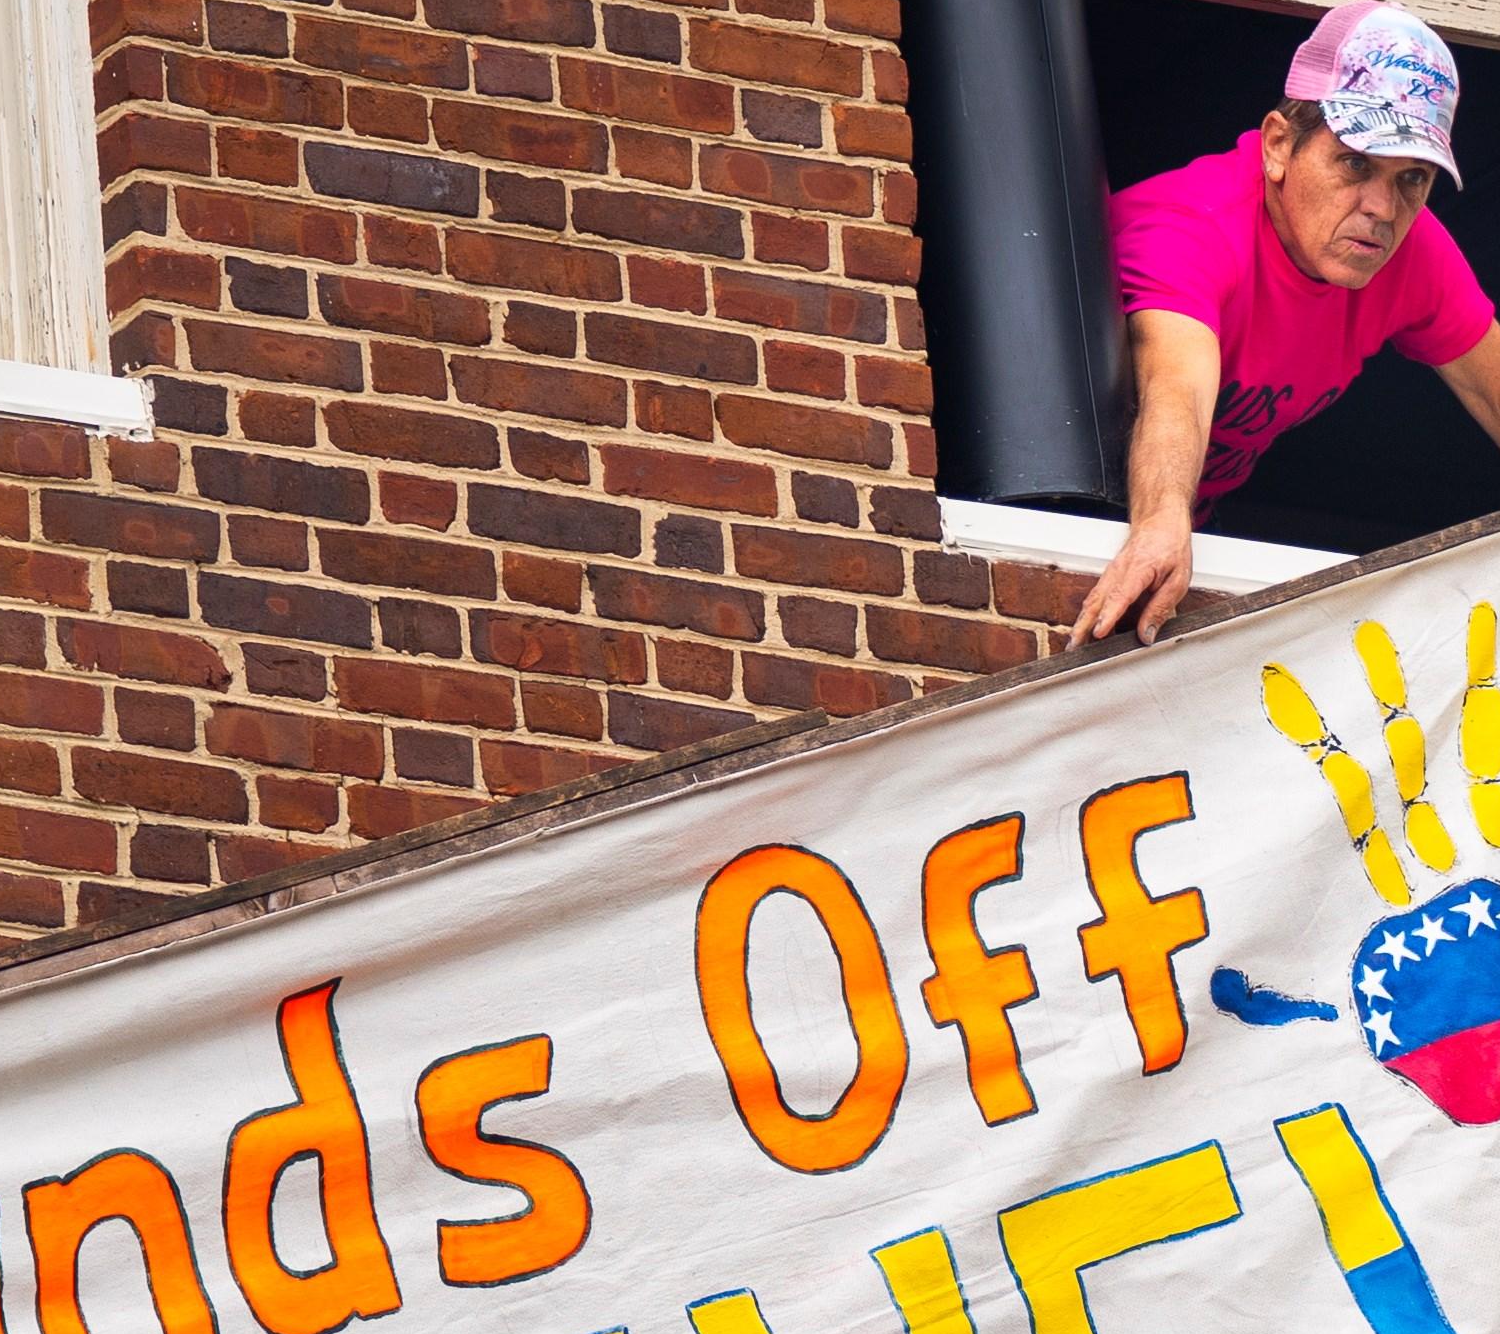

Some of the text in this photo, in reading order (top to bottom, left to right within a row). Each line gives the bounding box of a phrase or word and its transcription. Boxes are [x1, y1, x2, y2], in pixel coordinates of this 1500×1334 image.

[1365, 49, 1456, 92] Washing
[1407, 78, 1445, 106] DC
[690, 769, 1209, 1175] Off
